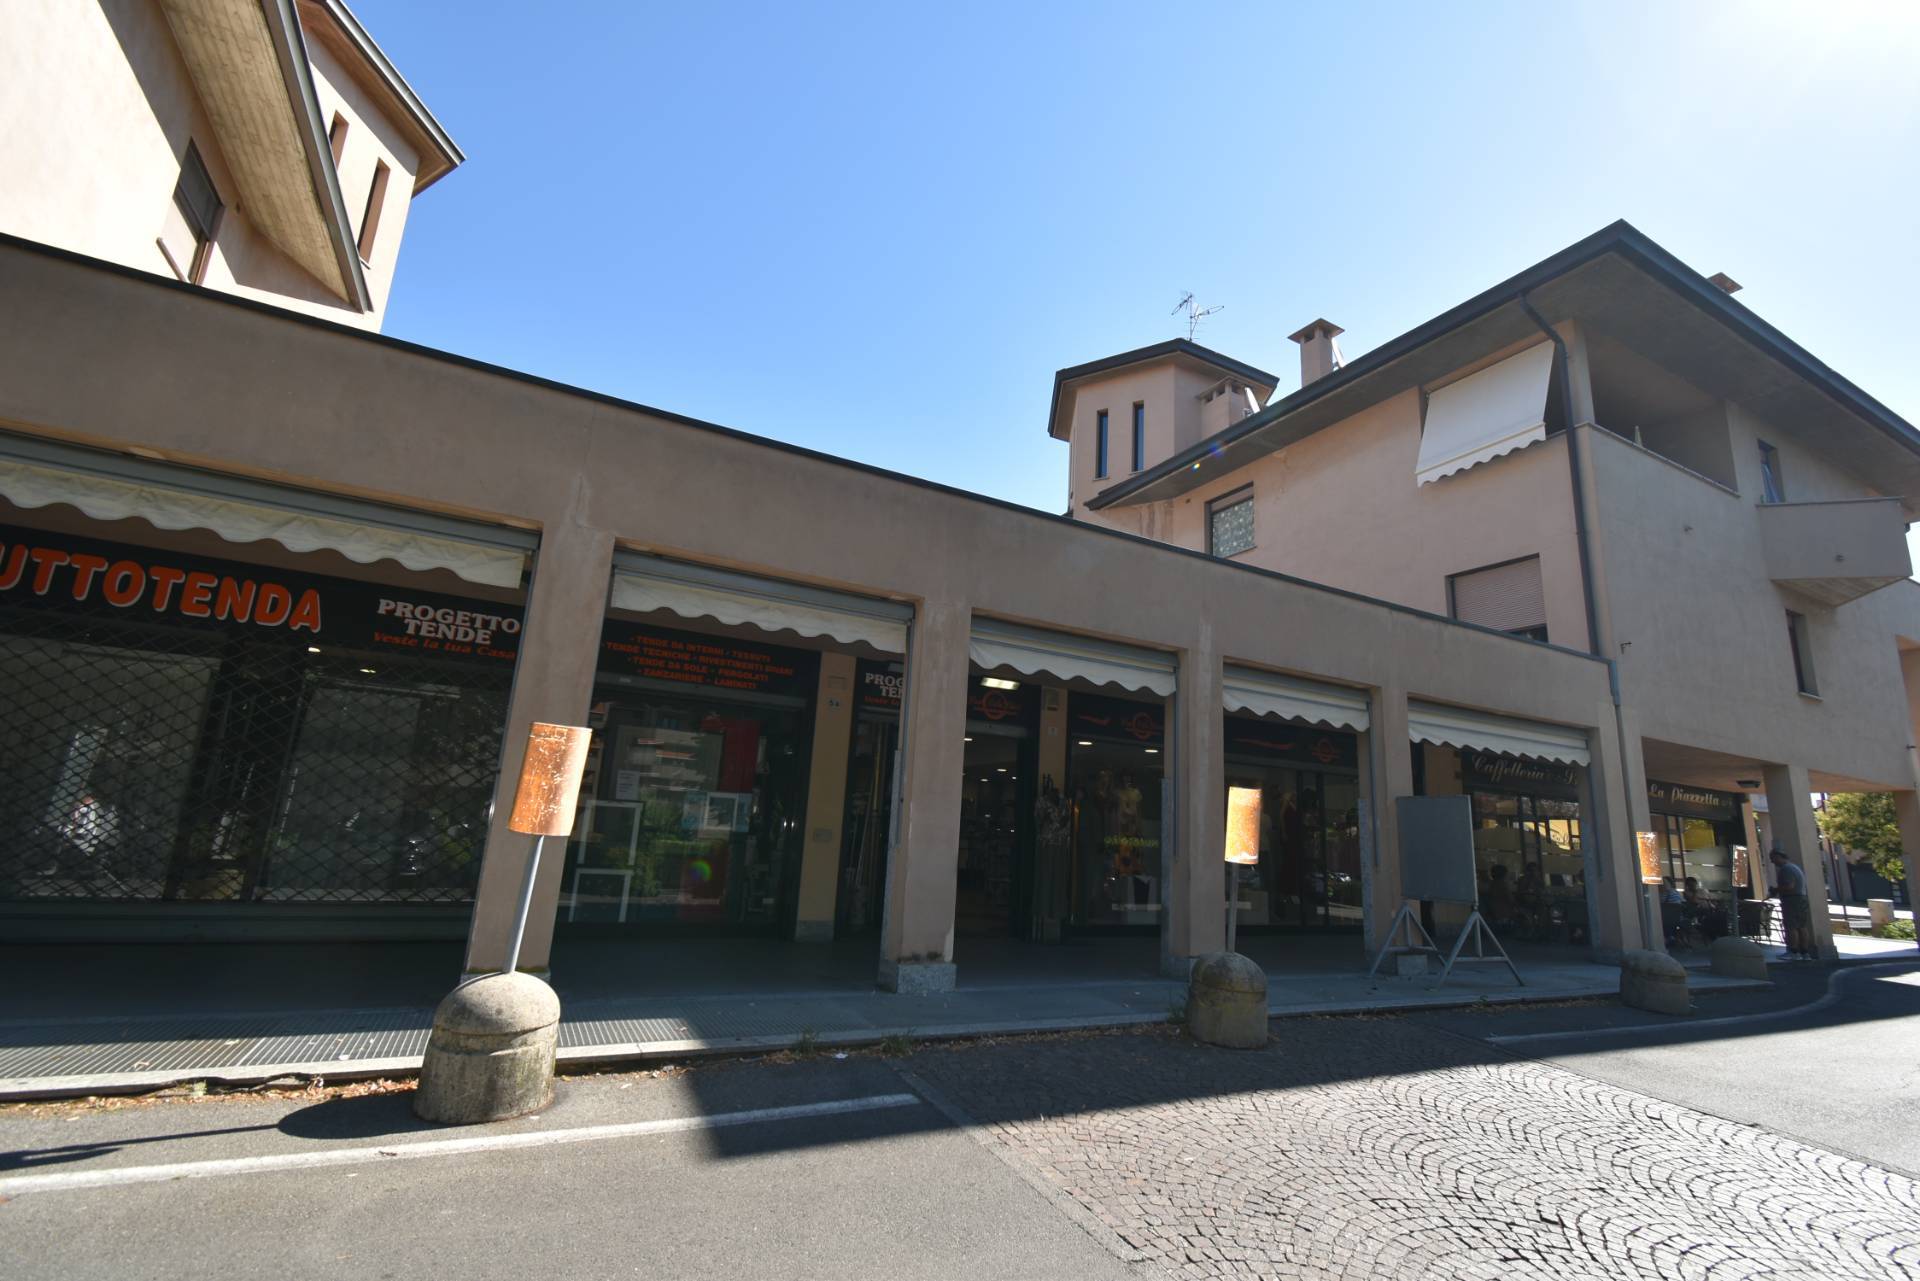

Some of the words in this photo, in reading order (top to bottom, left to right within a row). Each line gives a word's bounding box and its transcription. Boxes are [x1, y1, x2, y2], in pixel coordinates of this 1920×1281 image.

[377, 598, 521, 633] PROGETTO
[404, 618, 492, 644] TENDE
[374, 631, 418, 647] Veste
[423, 639, 439, 650] la
[444, 642, 472, 654] tua
[478, 645, 516, 660] Casa
[607, 641, 640, 654] TENDE
[642, 647, 690, 661] TECNICHE
[635, 635, 668, 649] TENDE
[671, 640, 684, 650] DA
[687, 641, 724, 656] INTERNI
[632, 655, 664, 669] TENDE
[668, 660, 681, 670] DA
[684, 662, 709, 675] SOLE
[1648, 783, 1665, 799] La
[1671, 786, 1720, 807] Piazzetta
